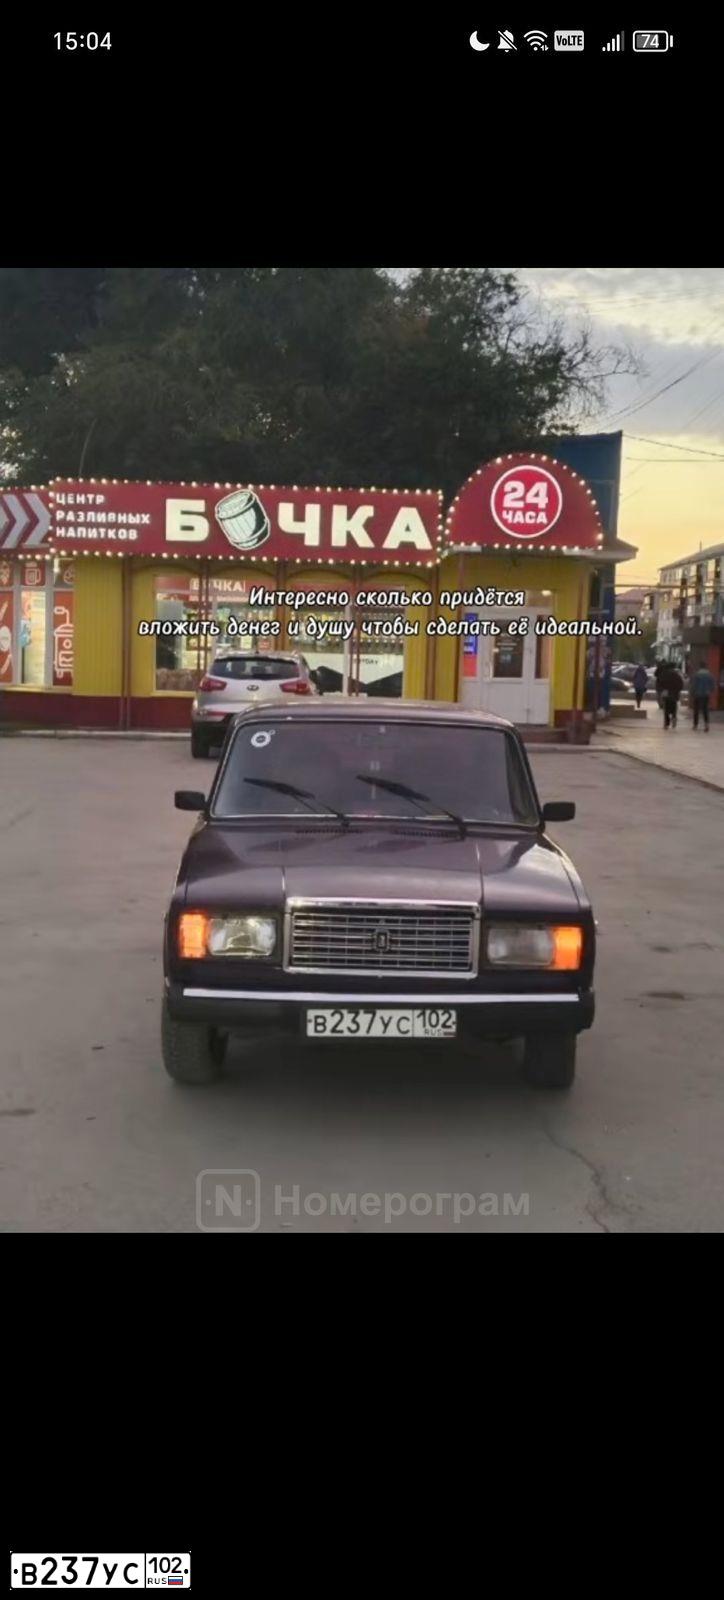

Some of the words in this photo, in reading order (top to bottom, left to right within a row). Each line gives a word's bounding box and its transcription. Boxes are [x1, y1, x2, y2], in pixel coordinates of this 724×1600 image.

[56, 493, 105, 505] ЦЕНТР
[502, 480, 549, 509] 24
[56, 510, 151, 524] РАЗЛИВНЫХ
[502, 510, 548, 525] ЧАСА
[56, 527, 138, 540] НАПИТКОВ
[313, 1010, 411, 1034] В237УС
[416, 1010, 453, 1029] 102
[424, 1028, 443, 1037] RUS
